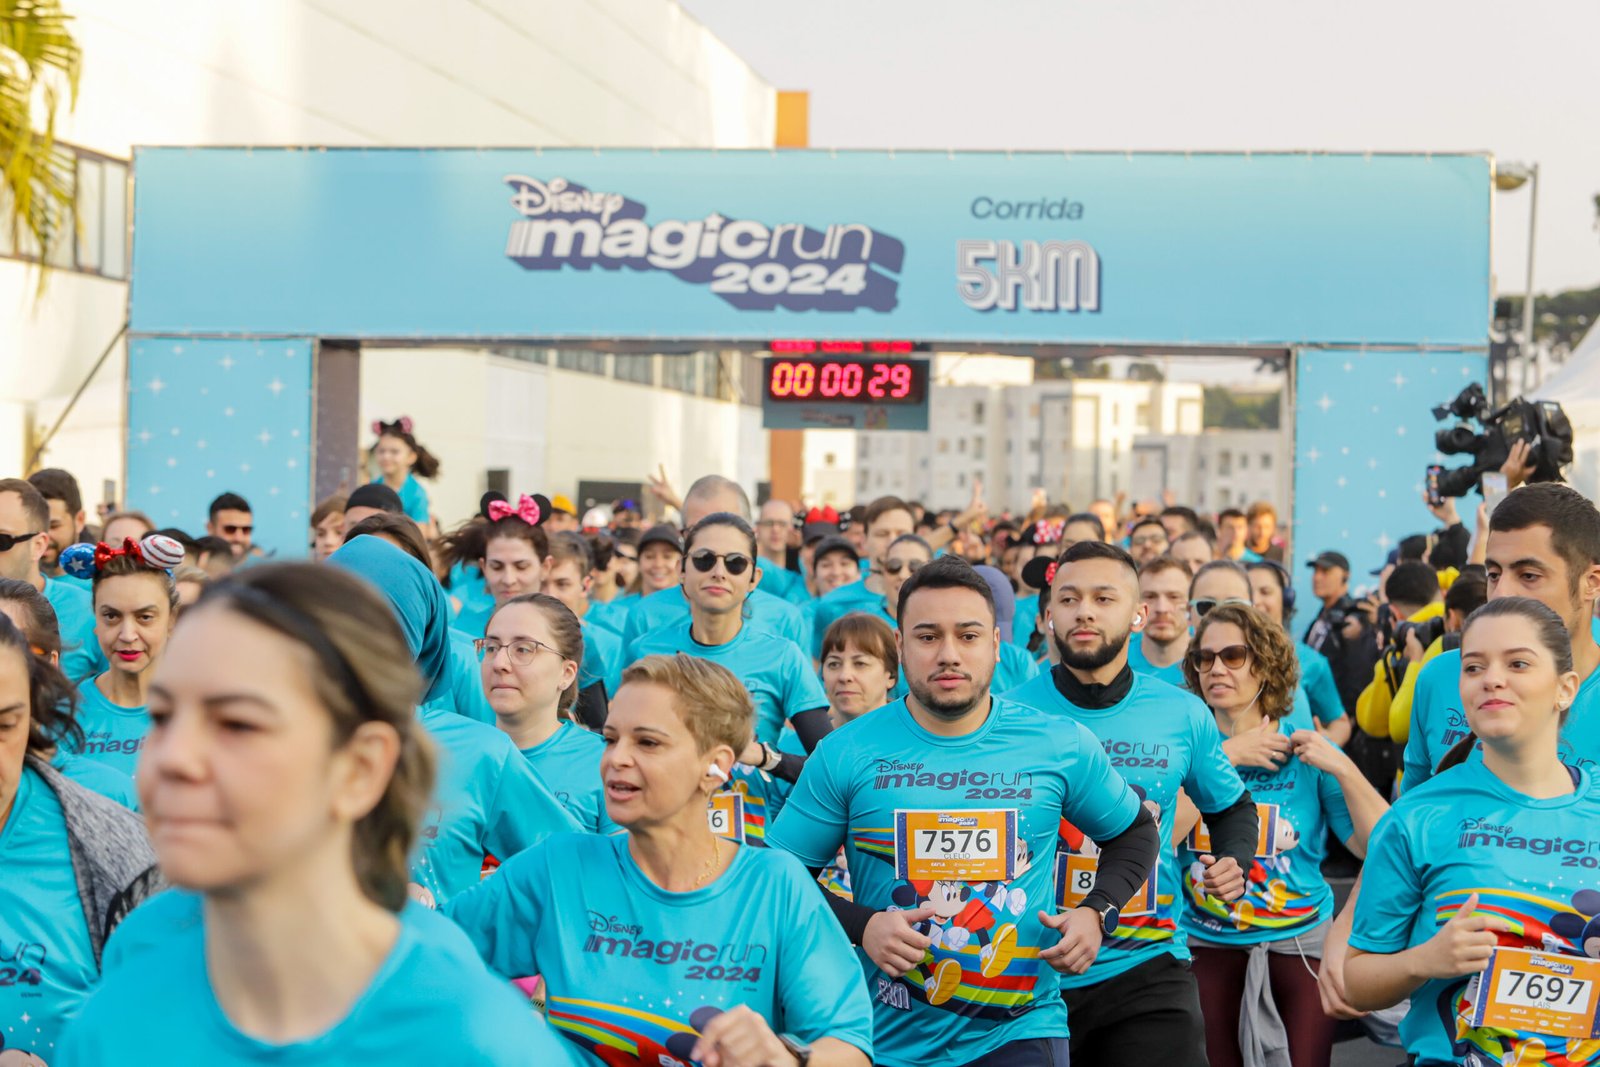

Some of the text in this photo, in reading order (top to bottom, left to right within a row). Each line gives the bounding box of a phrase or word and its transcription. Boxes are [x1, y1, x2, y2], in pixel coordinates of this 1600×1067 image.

[503, 174, 625, 227] Disney
[970, 196, 1084, 220] Corrida
[711, 261, 867, 295] 2024
[956, 239, 1102, 314] 5KM
[771, 362, 912, 398] 00 00 29
[873, 759, 924, 774] Disney
[1110, 756, 1168, 769] 2024
[873, 769, 1032, 790] magicrun
[965, 788, 1032, 799] 2024
[1458, 817, 1513, 837] Disney
[922, 829, 992, 853] 7576
[1458, 832, 1600, 855] magicr
[1561, 856, 1600, 869] 20
[587, 910, 643, 942] Disney
[583, 934, 767, 965] magicrun
[0, 967, 42, 986] 24
[684, 965, 762, 983] 2024
[1508, 971, 1585, 1005] 7697
